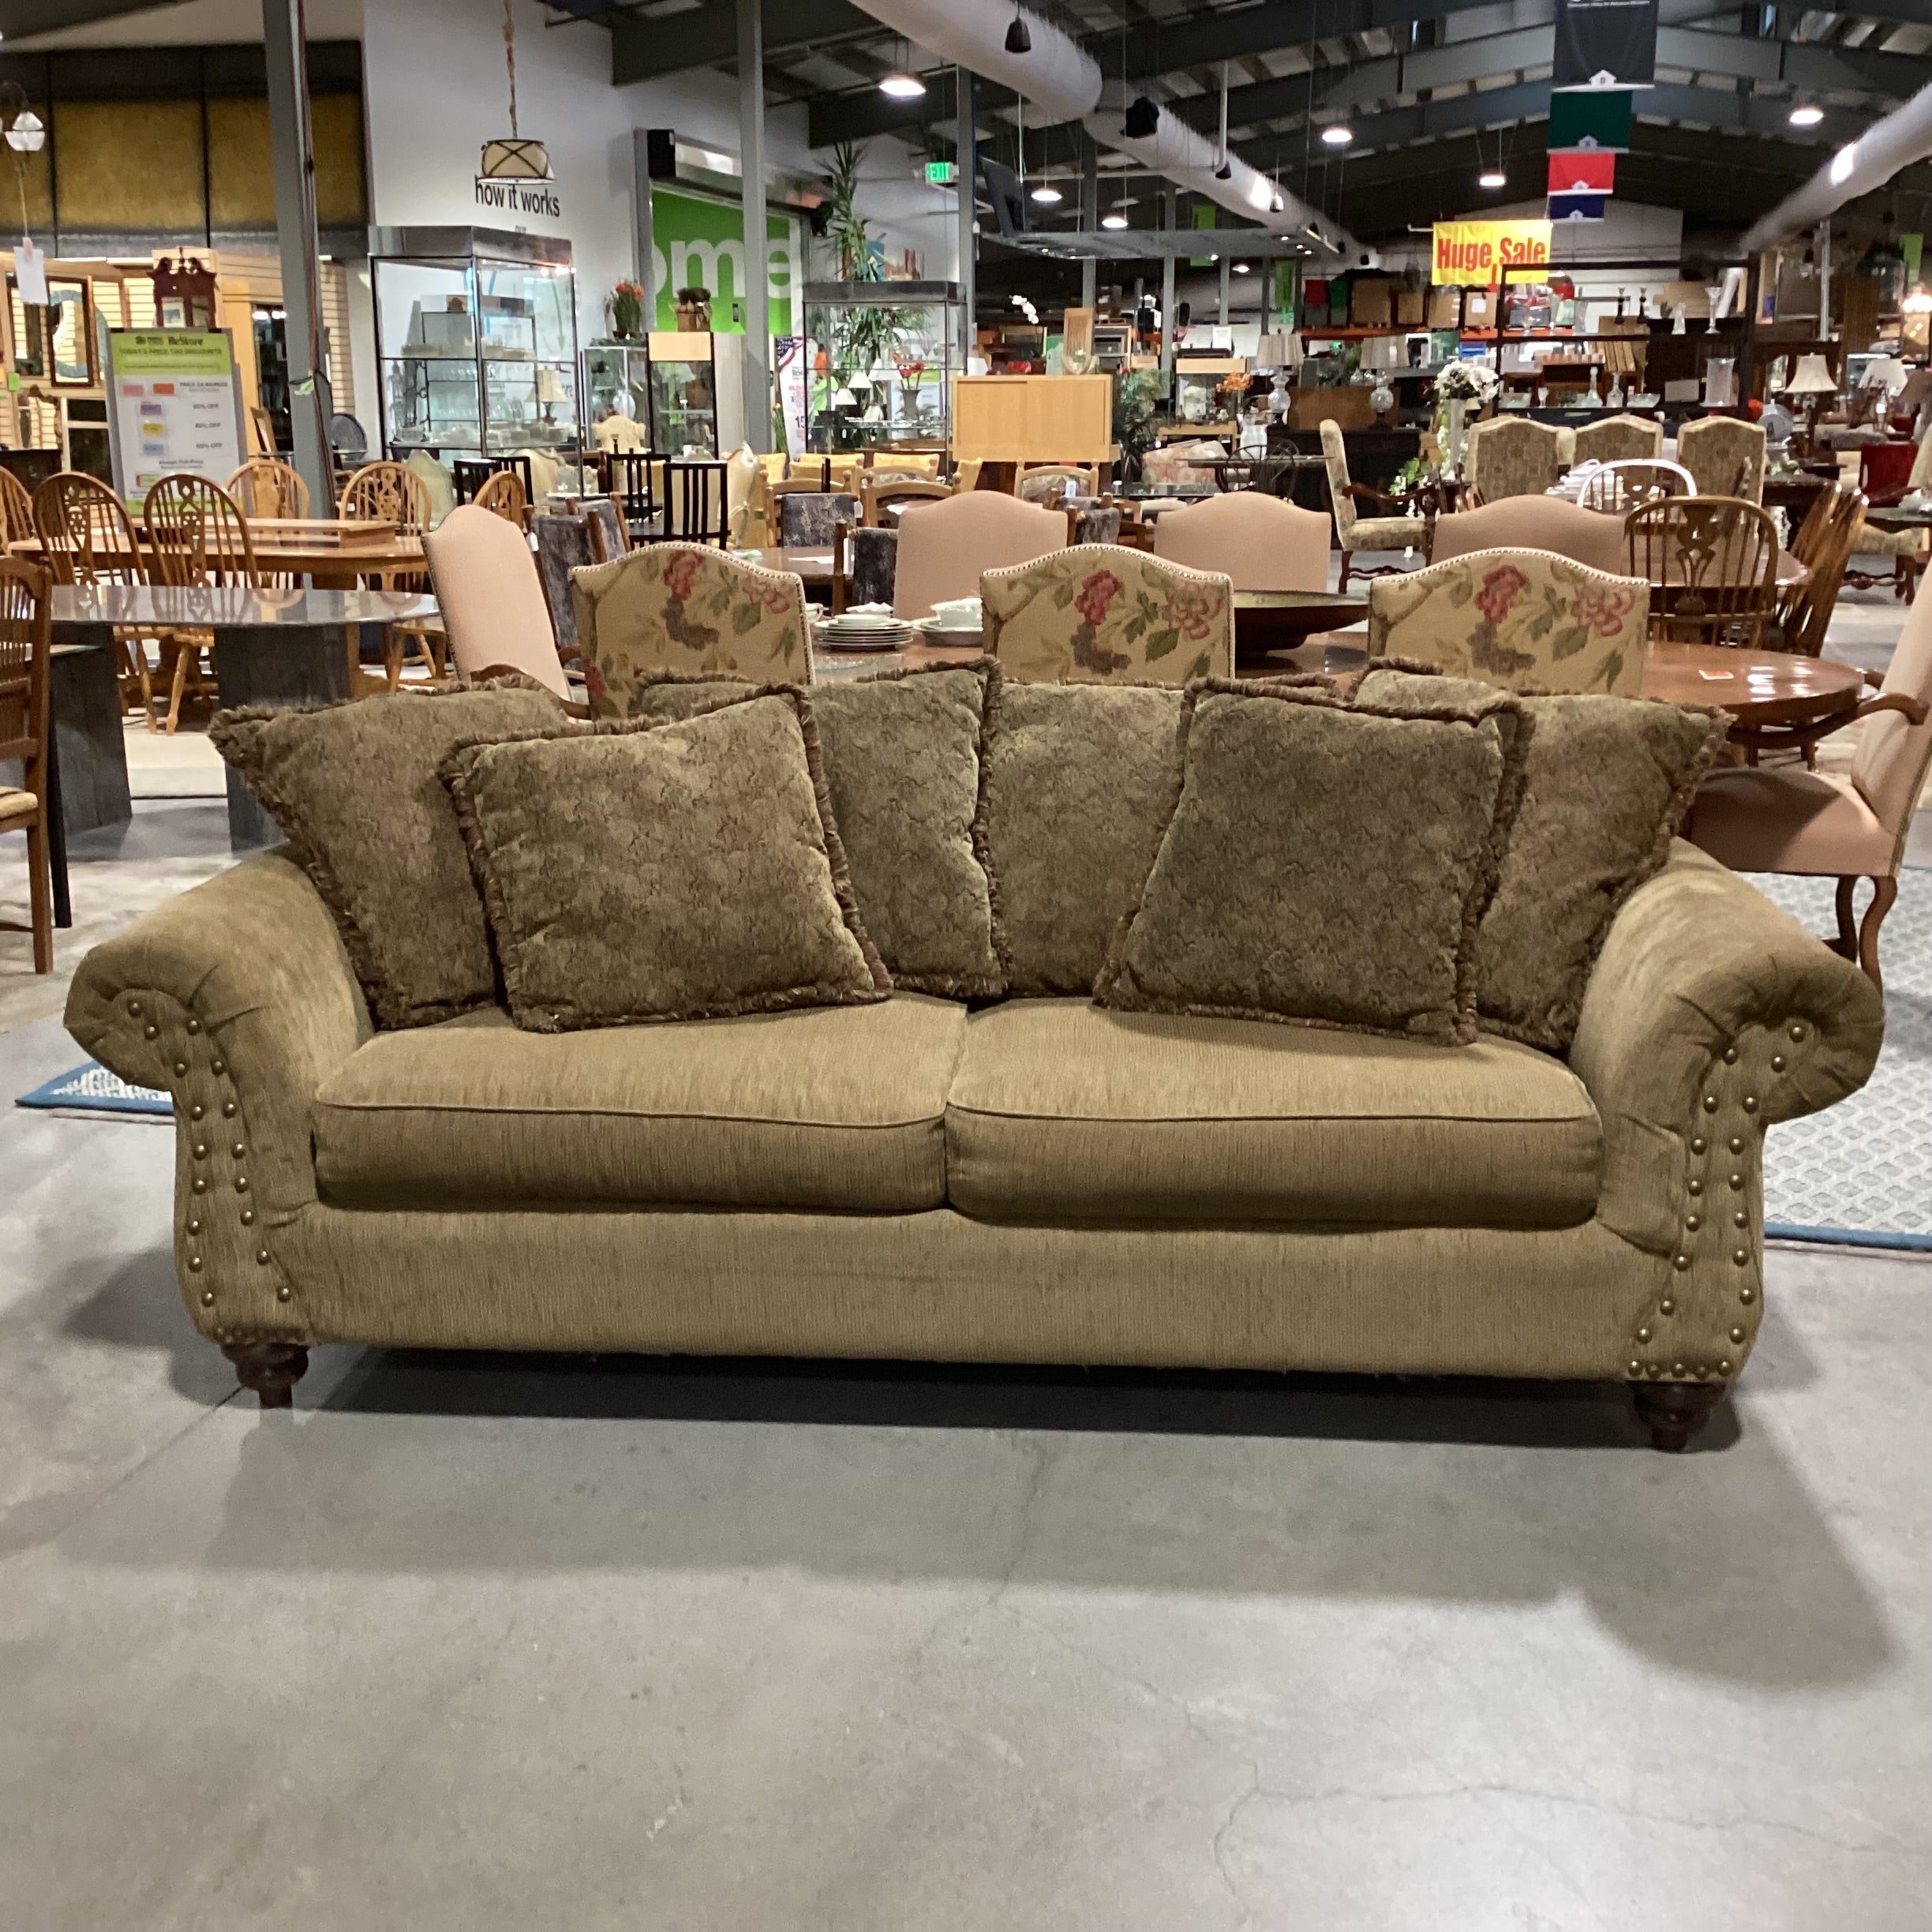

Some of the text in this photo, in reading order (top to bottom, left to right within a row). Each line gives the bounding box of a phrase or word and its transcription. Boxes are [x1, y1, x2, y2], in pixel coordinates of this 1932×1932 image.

[930, 163, 949, 180] EXIT
[474, 174, 560, 218] how it works
[653, 238, 791, 299] me
[1437, 237, 1546, 272] Huge Sale
